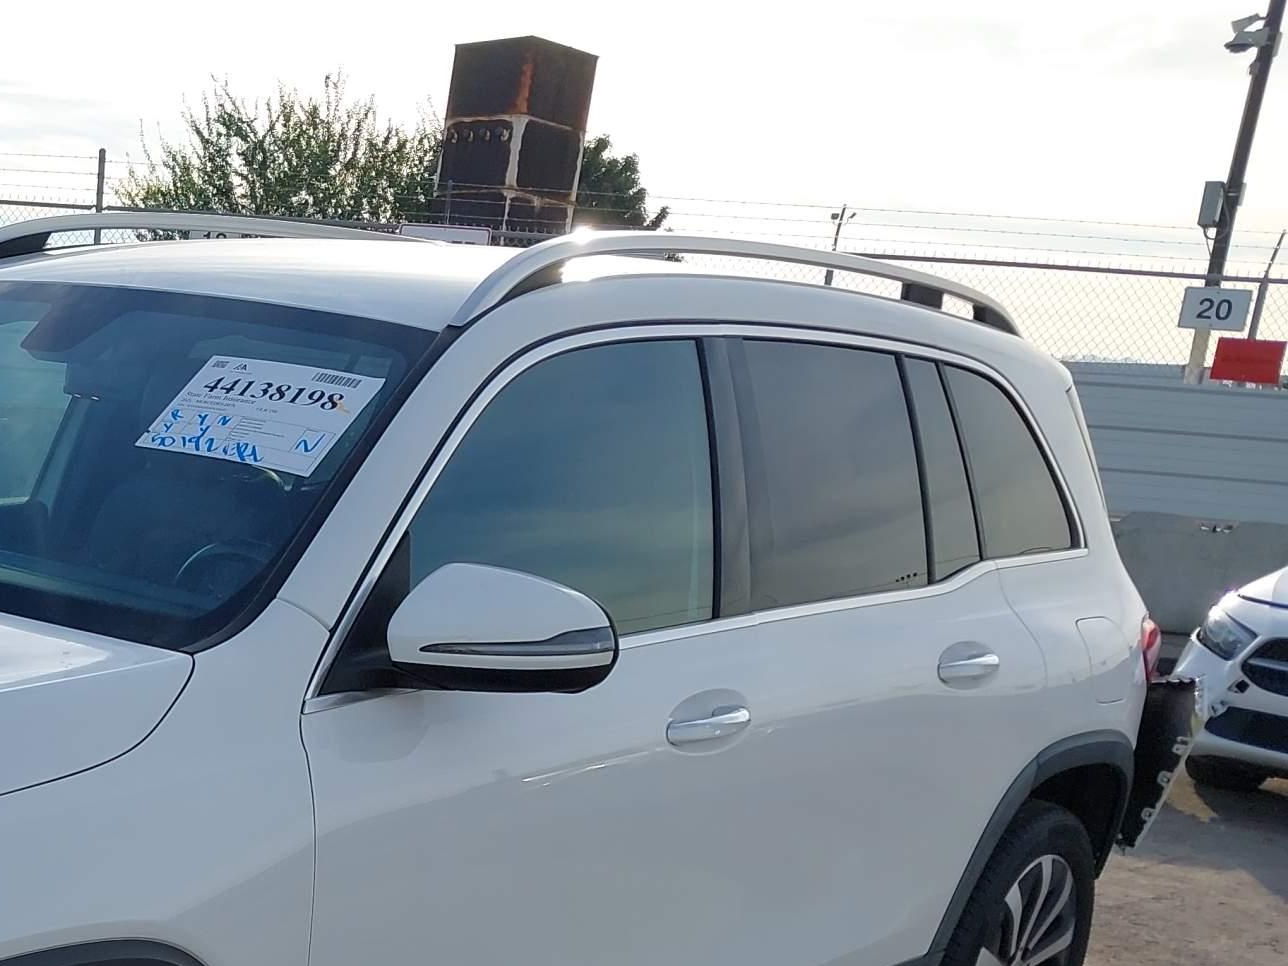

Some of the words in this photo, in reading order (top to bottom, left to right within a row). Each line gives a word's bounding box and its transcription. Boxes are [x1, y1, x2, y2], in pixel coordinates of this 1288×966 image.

[1196, 298, 1233, 322] 20
[203, 376, 344, 411] 44138198
[203, 393, 222, 401] Farm
[222, 395, 256, 405] Insurance
